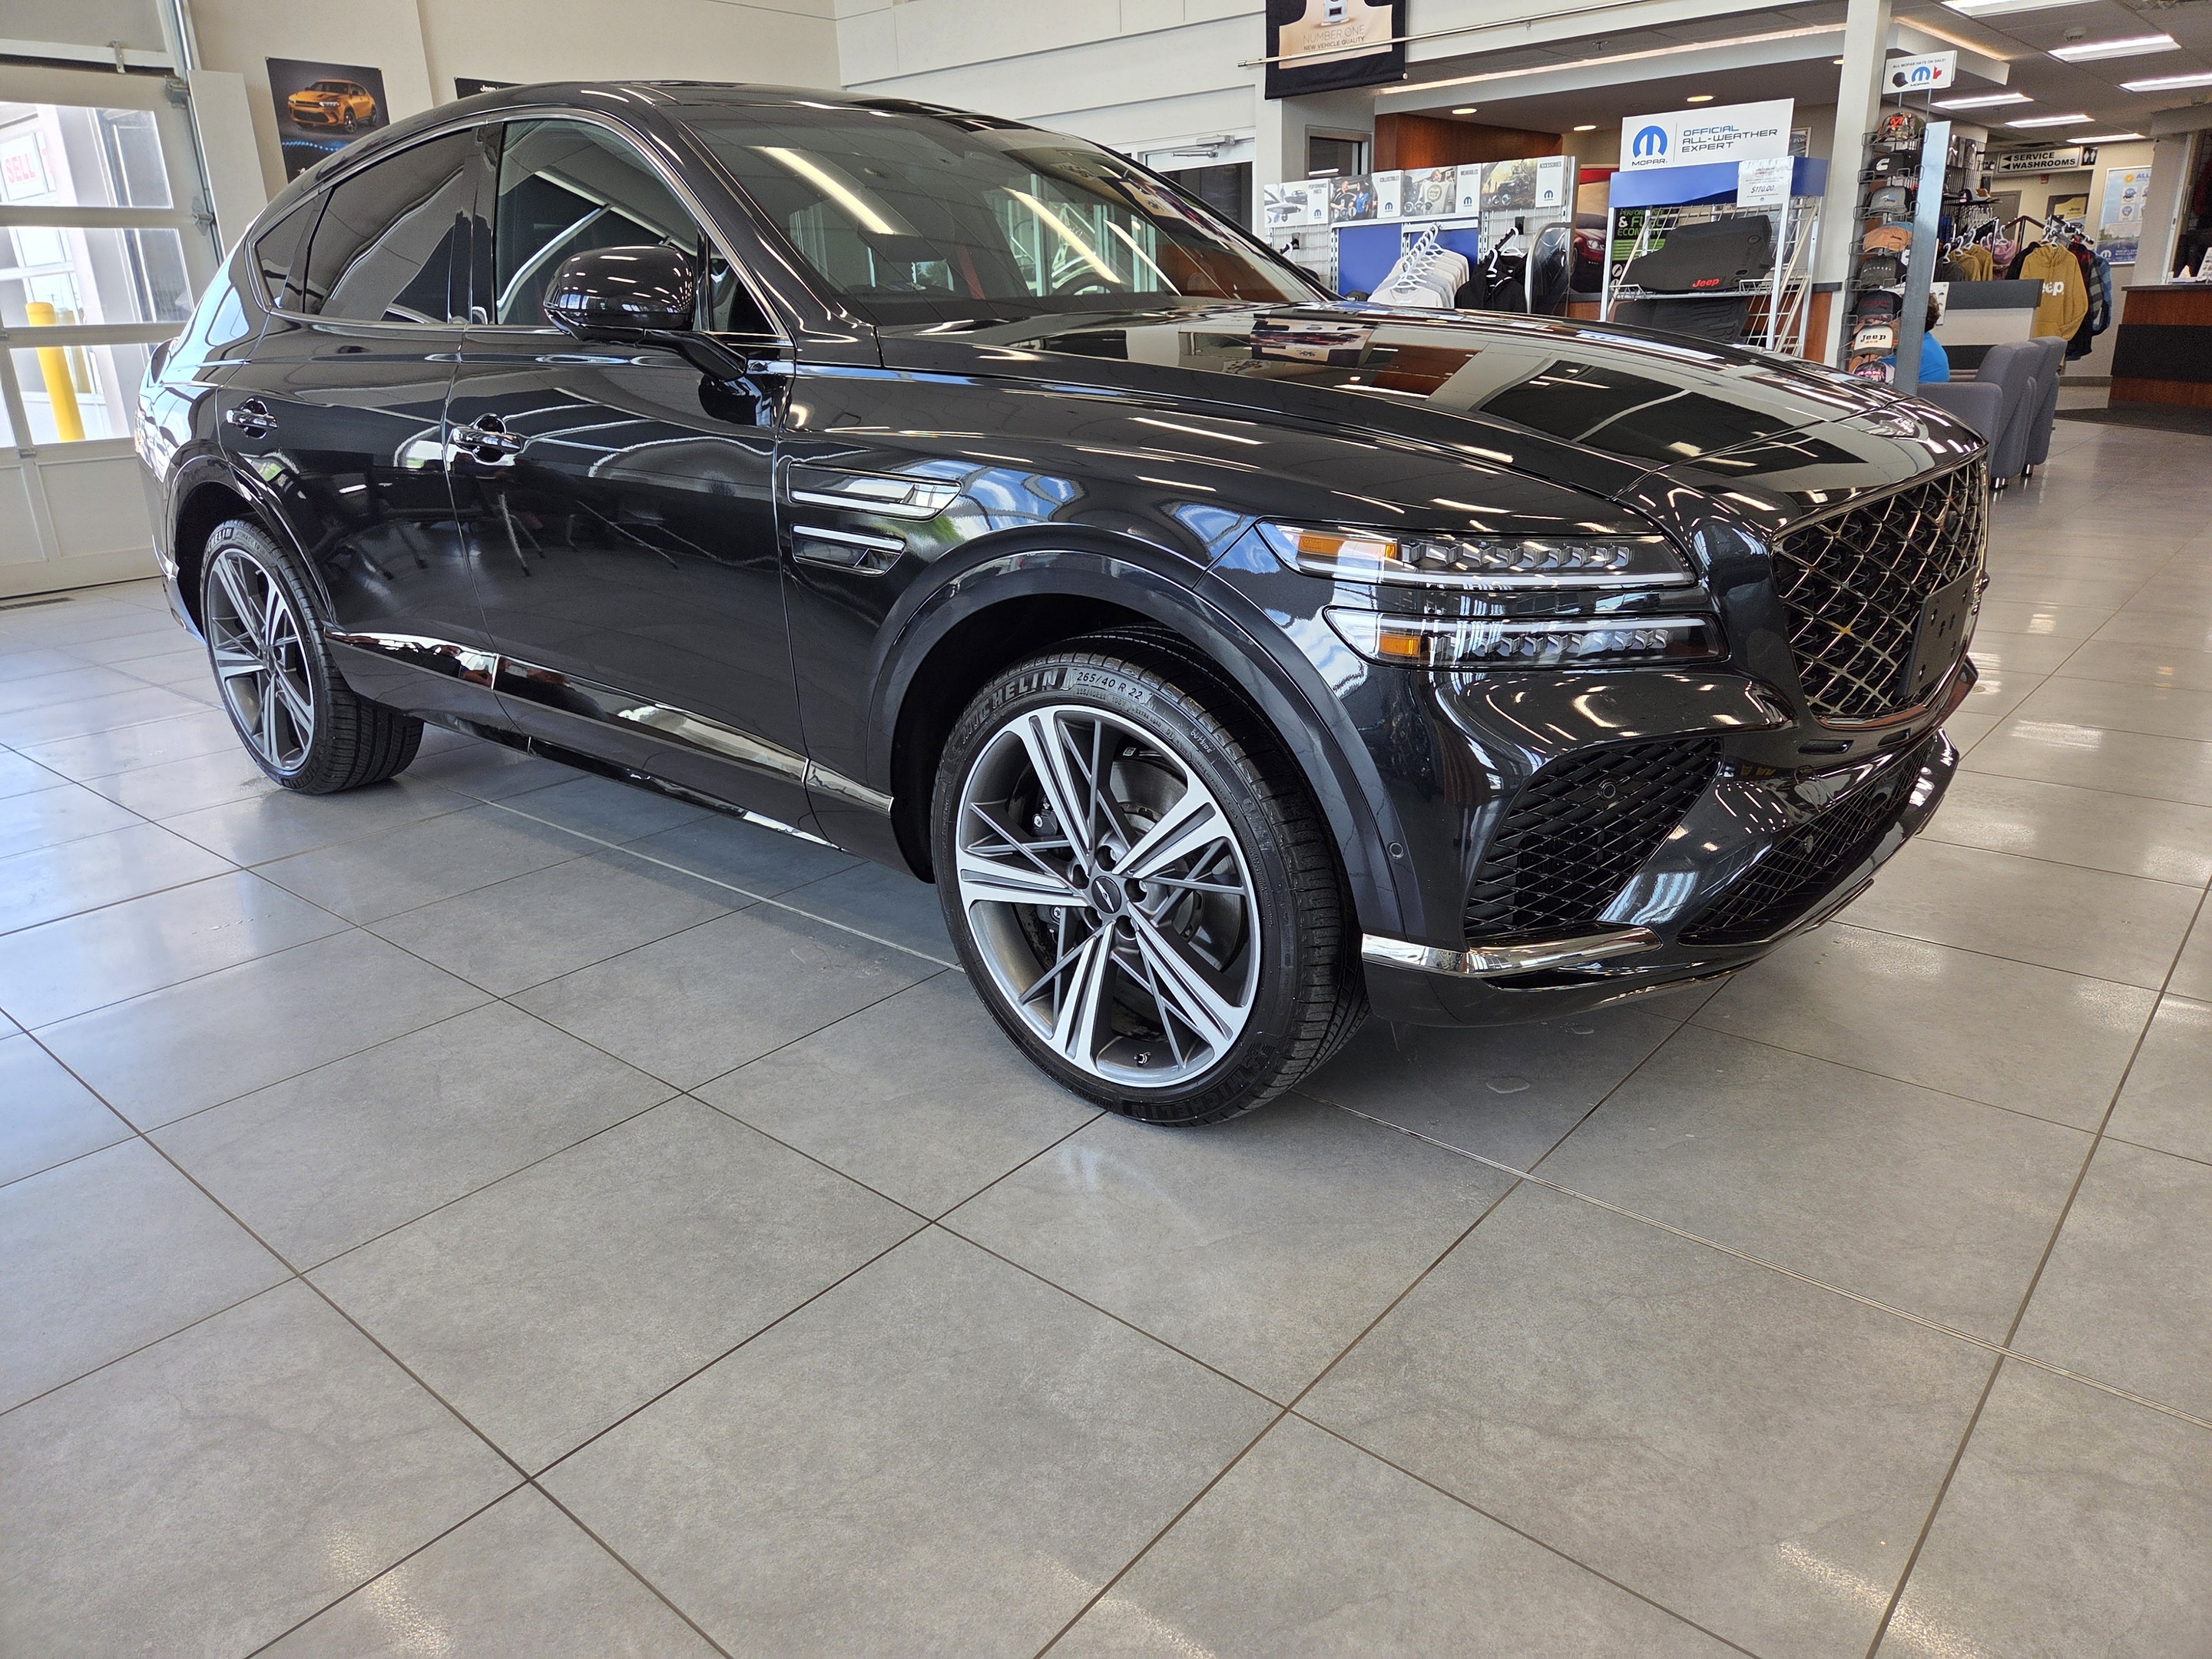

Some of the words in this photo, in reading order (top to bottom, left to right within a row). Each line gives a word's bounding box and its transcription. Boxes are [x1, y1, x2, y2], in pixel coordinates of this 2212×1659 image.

[1303, 29, 1343, 44] NUMBER
[1344, 24, 1366, 38] ONE
[1317, 40, 1340, 50] VEHICLE
[1341, 35, 1366, 46] QUALITY
[1682, 128, 1778, 145] ALL-WEATHER
[1683, 124, 1740, 137] OFFICIAL
[1681, 141, 1734, 154] EXPERT
[1631, 157, 1666, 167] MOPAR
[2013, 151, 2055, 161] SERVICE
[5, 154, 36, 183] SELL
[2012, 158, 2076, 170] WASHROOMS
[1751, 185, 1775, 194] $170.00
[1618, 216, 1628, 228] &
[1692, 278, 1720, 288] Jeep
[2042, 280, 2065, 296] eep
[1860, 334, 1886, 343] Jeep
[1077, 671, 1116, 688] 265/40
[1118, 683, 1127, 693] R
[1128, 687, 1143, 700] 22
